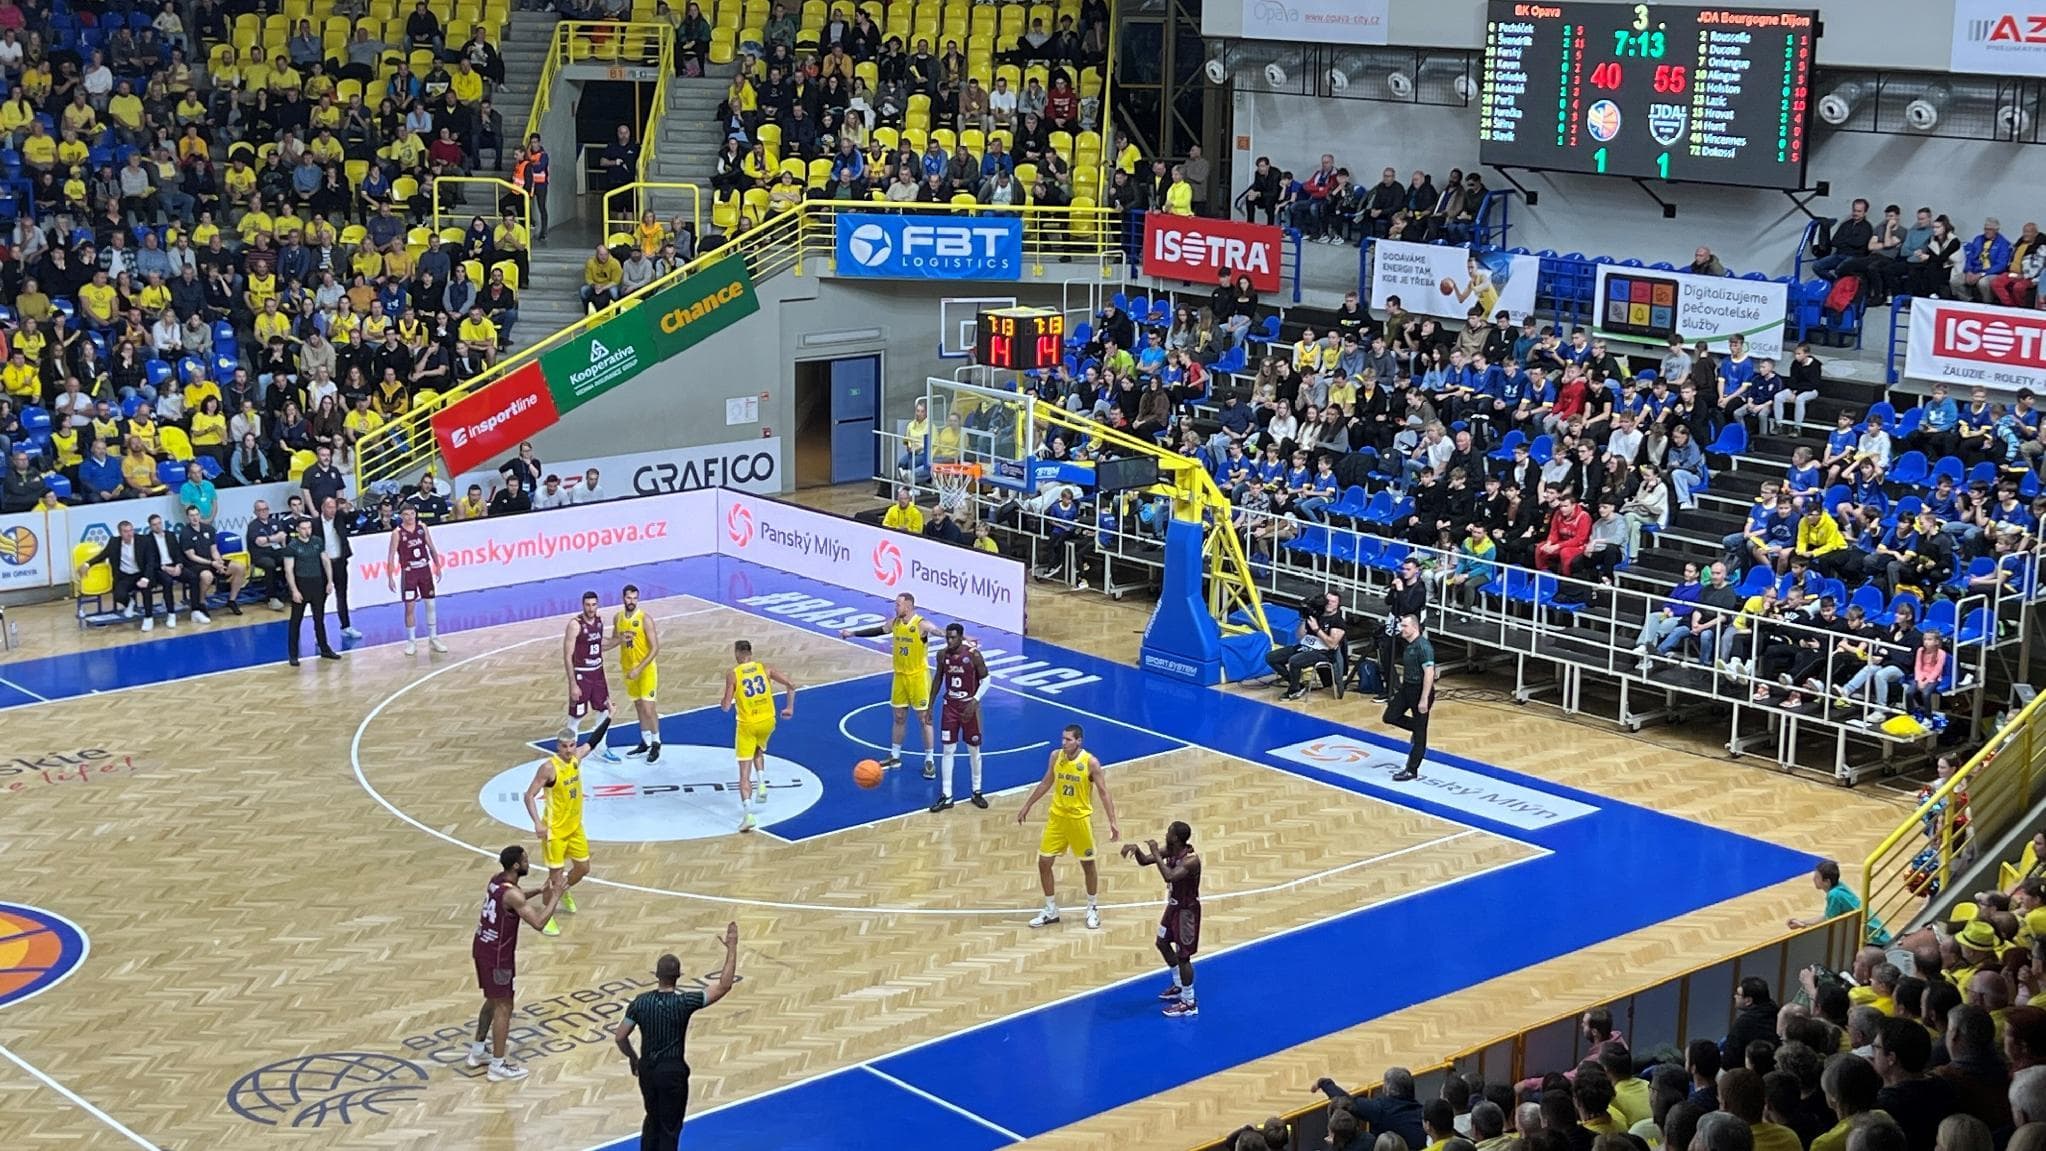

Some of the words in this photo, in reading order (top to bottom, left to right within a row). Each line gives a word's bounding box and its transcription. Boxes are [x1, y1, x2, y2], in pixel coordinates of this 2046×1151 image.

[1515, 4, 1529, 16] BK
[1531, 5, 1561, 18] Opava
[1697, 11, 1719, 24] JDA
[1721, 12, 1779, 27] Bourgogne
[1781, 14, 1810, 28] Dijon
[1563, 37, 1570, 48] 2
[1614, 30, 1665, 58] 7:13
[1699, 30, 1707, 42] 2
[1698, 56, 1706, 67] 7
[1590, 62, 1622, 90] 40
[1654, 65, 1687, 93] 55
[1694, 81, 1705, 92] 11
[1781, 99, 1789, 111] 2
[1594, 147, 1607, 174] 1
[1656, 152, 1670, 178] 1
[1791, 151, 1800, 162] 5
[903, 226, 1009, 257] FBT
[1155, 229, 1270, 274] ISOTRA
[902, 257, 1009, 269] LOGISTICS
[1382, 274, 1397, 284] KDE
[1400, 276, 1409, 285] JE
[1411, 276, 1435, 288] TŘEBA
[660, 278, 744, 334] Chance
[1684, 284, 1768, 305] Digitalizujeme
[1683, 302, 1760, 320] pečovatelské
[1682, 317, 1719, 334] služby
[991, 335, 1010, 367] 14
[1037, 335, 1058, 366] 14
[1945, 318, 2046, 360] ISOT
[569, 345, 635, 385] Kooperativa
[1943, 364, 1985, 380] ŽALUZIE
[1994, 372, 2036, 387] ROLETY
[468, 393, 538, 440] insportline
[632, 452, 775, 497] GRAFICO
[760, 521, 812, 549] Panský
[814, 535, 851, 563] Mlýn
[911, 559, 969, 592] Panský
[971, 576, 1011, 605] Mlýn
[589, 643, 600, 655] 13
[742, 675, 766, 698] 33
[951, 676, 962, 688] 10
[1482, 792, 1559, 820] Mlýn
